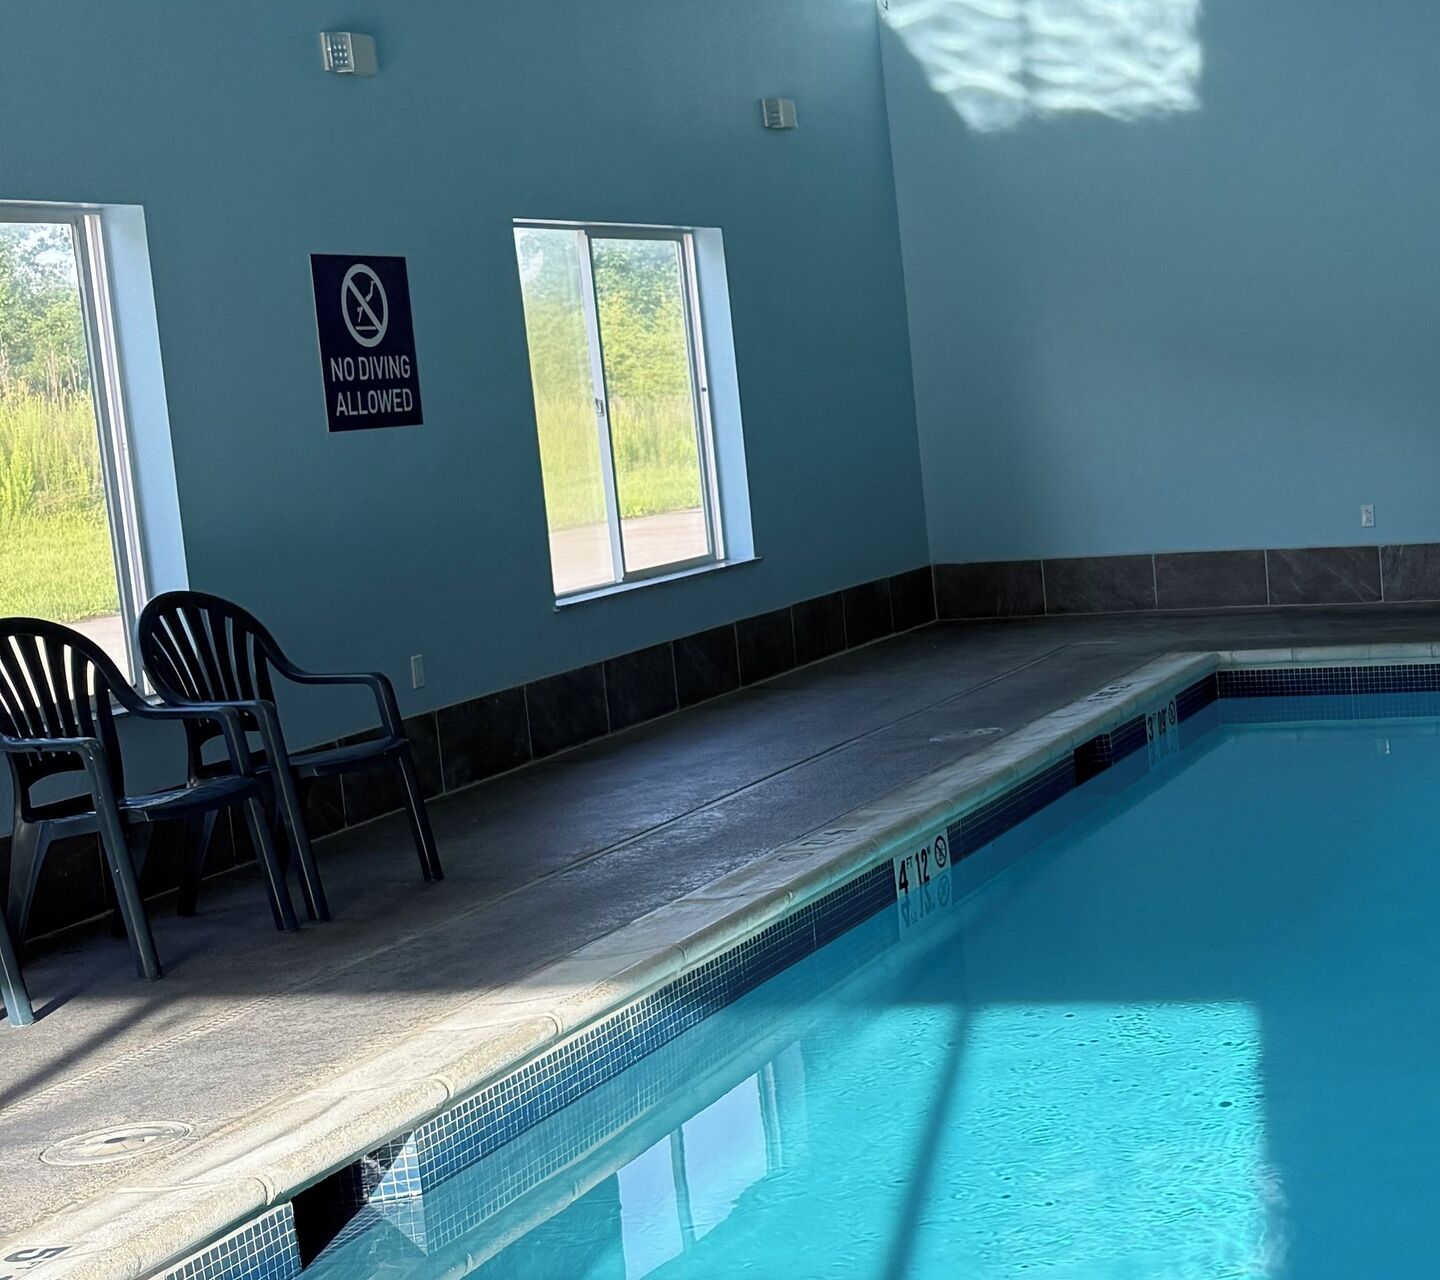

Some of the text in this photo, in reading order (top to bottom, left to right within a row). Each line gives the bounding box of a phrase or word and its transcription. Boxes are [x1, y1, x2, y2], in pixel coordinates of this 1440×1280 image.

[330, 355, 411, 382] NO DIVING
[336, 388, 413, 416] ALLOWED
[899, 859, 909, 894] 4
